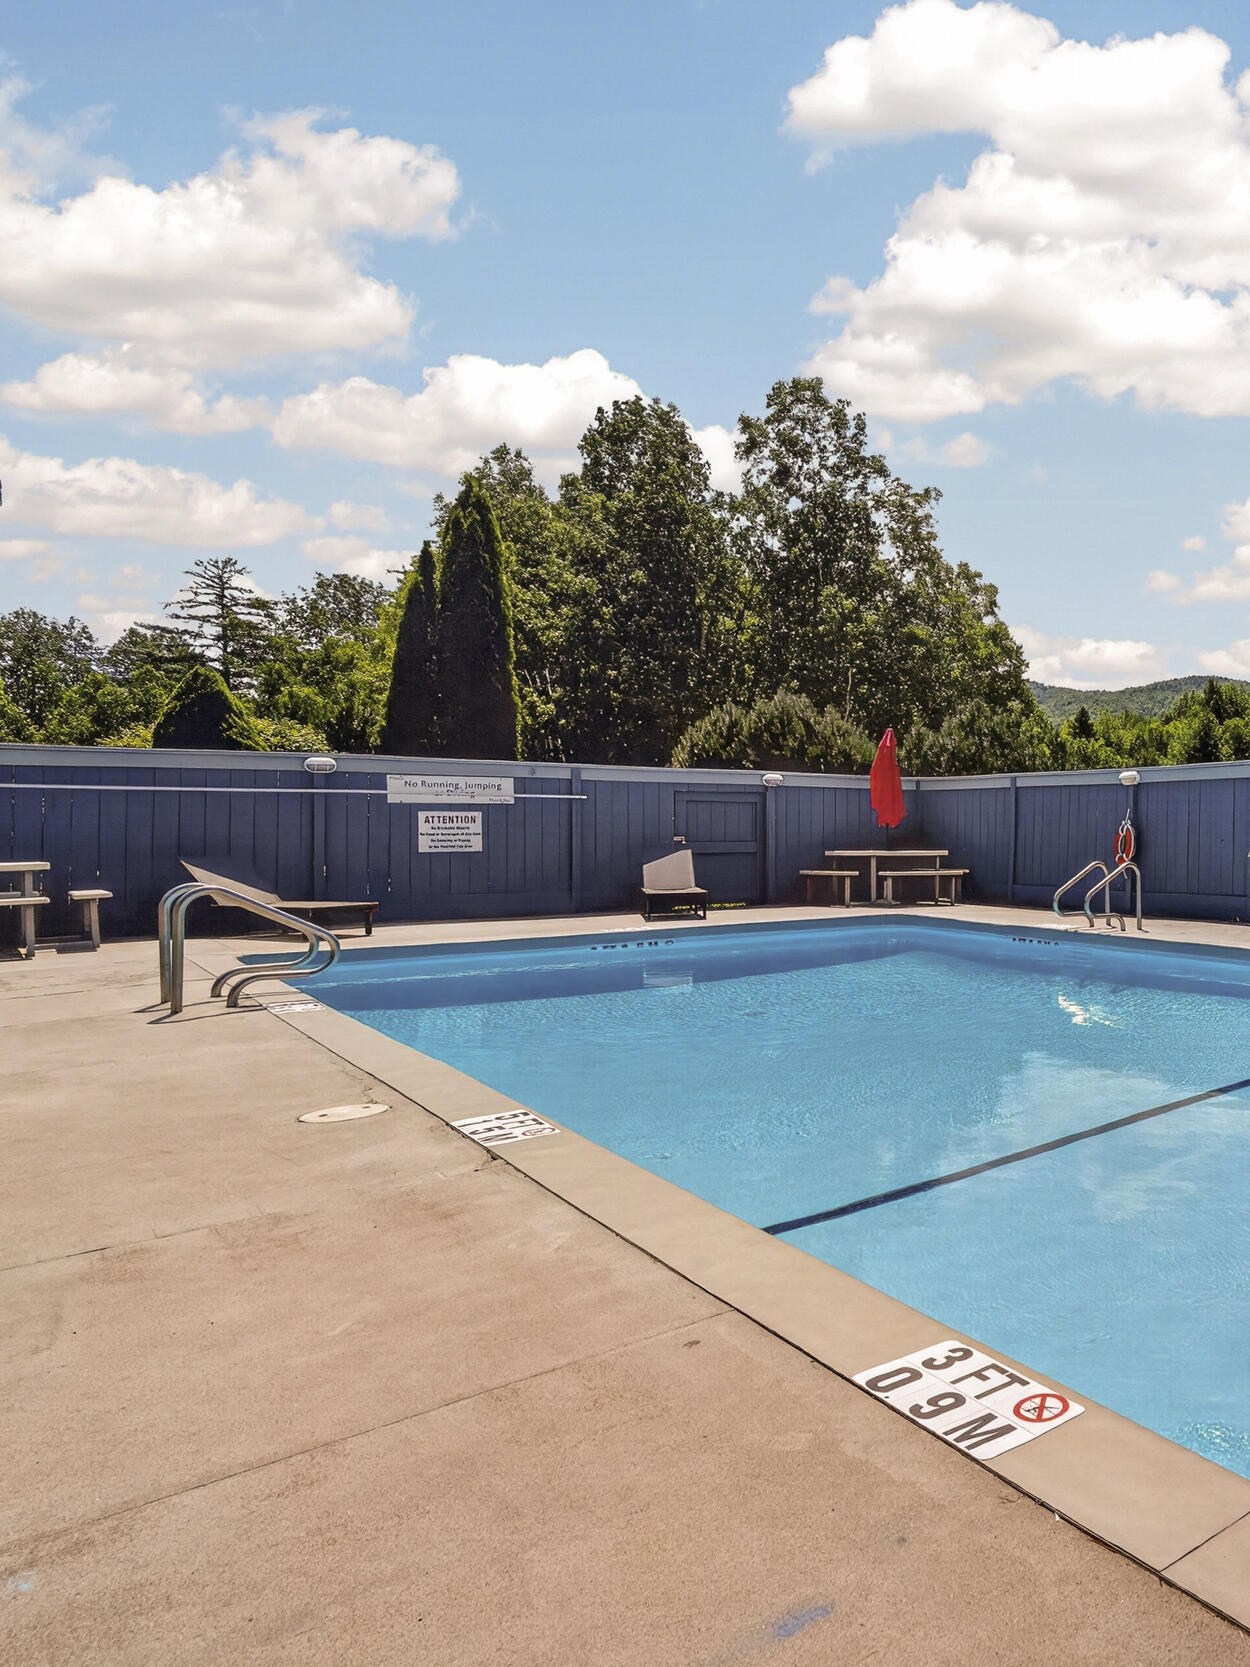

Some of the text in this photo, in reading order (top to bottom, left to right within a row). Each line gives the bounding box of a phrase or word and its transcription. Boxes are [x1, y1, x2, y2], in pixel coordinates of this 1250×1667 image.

[421, 780, 462, 790] Running,
[465, 782, 502, 791] Jumping
[424, 815, 476, 824] ATTENTION
[494, 1111, 545, 1129] 5 FT
[477, 1132, 519, 1144] M
[921, 1347, 1031, 1400] 3 FT
[942, 1412, 1018, 1451] M
